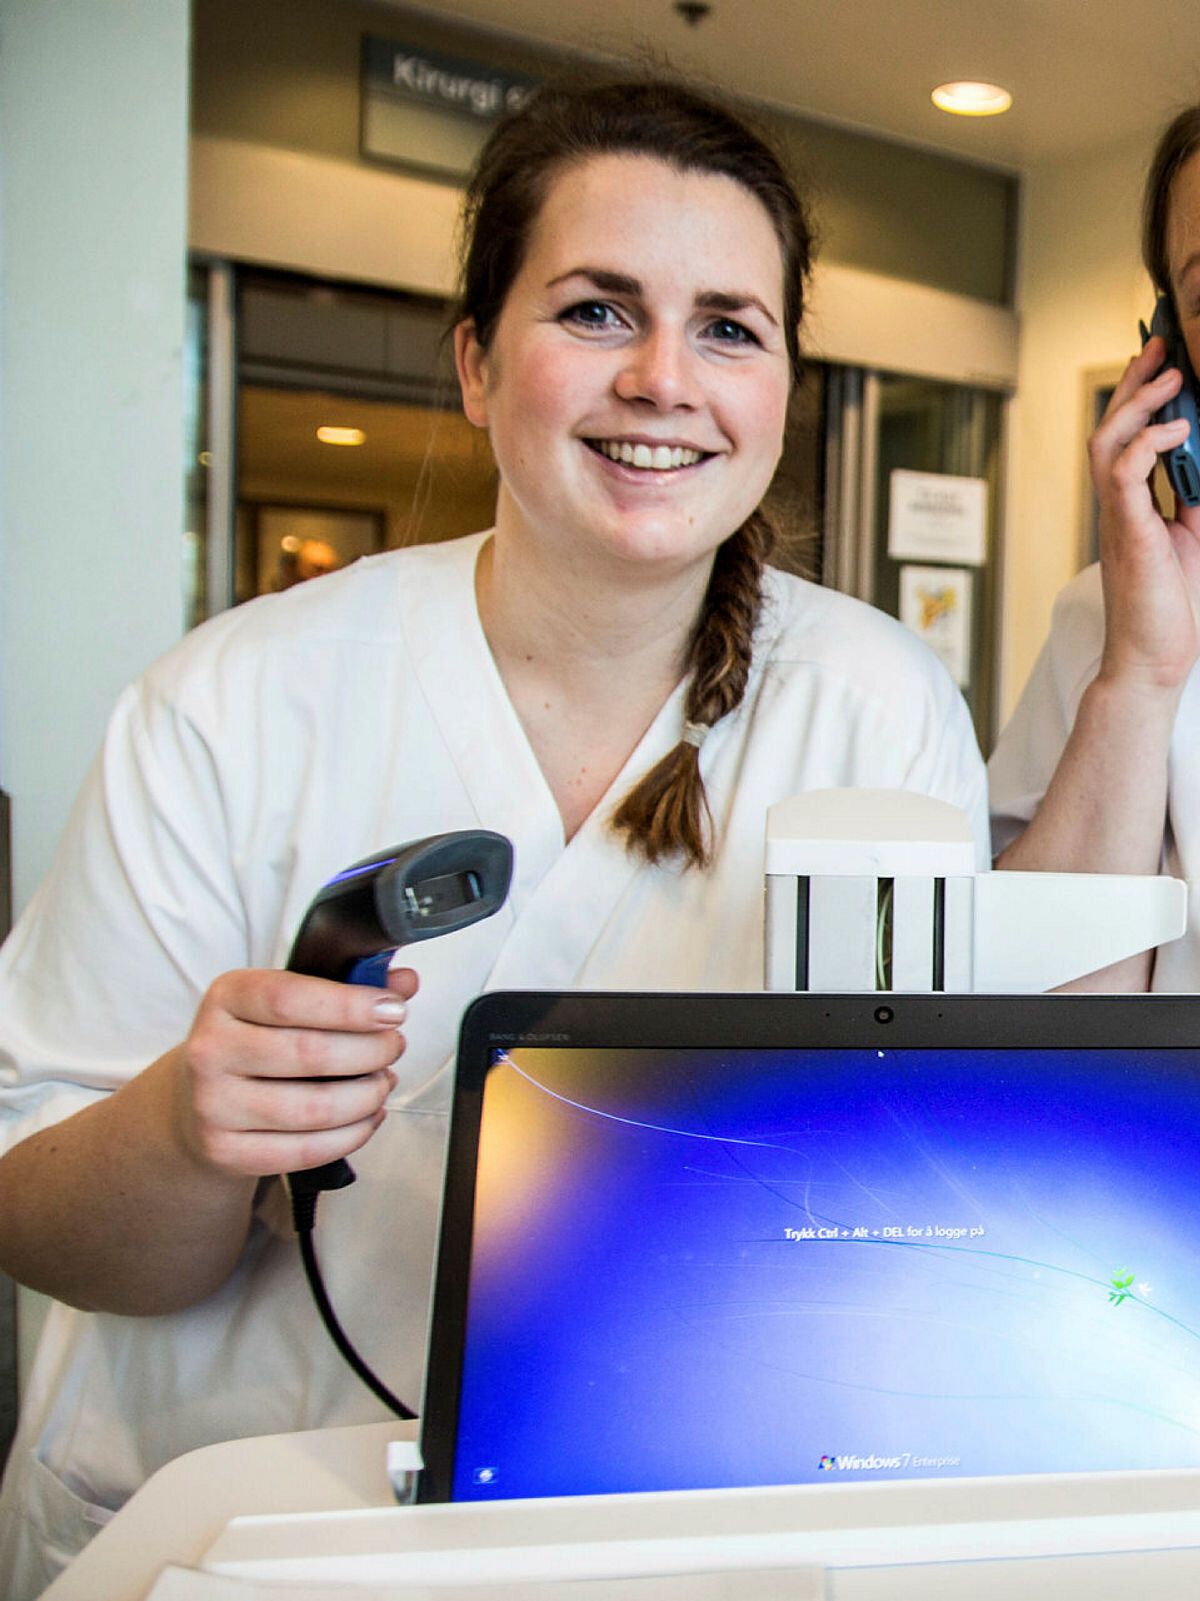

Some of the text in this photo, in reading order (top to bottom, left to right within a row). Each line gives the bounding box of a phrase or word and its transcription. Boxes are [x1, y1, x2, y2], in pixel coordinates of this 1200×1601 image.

[393, 53, 499, 116] Kirurgi
[784, 1227, 815, 1242] Trykk
[817, 1227, 838, 1239] Ctrl
[852, 1227, 869, 1238] Alt
[883, 1227, 905, 1238] DEL
[907, 1226, 923, 1237] for
[925, 1226, 933, 1237] å
[935, 1225, 967, 1239] logge
[970, 1226, 984, 1238] på
[837, 1454, 900, 1470] Windows
